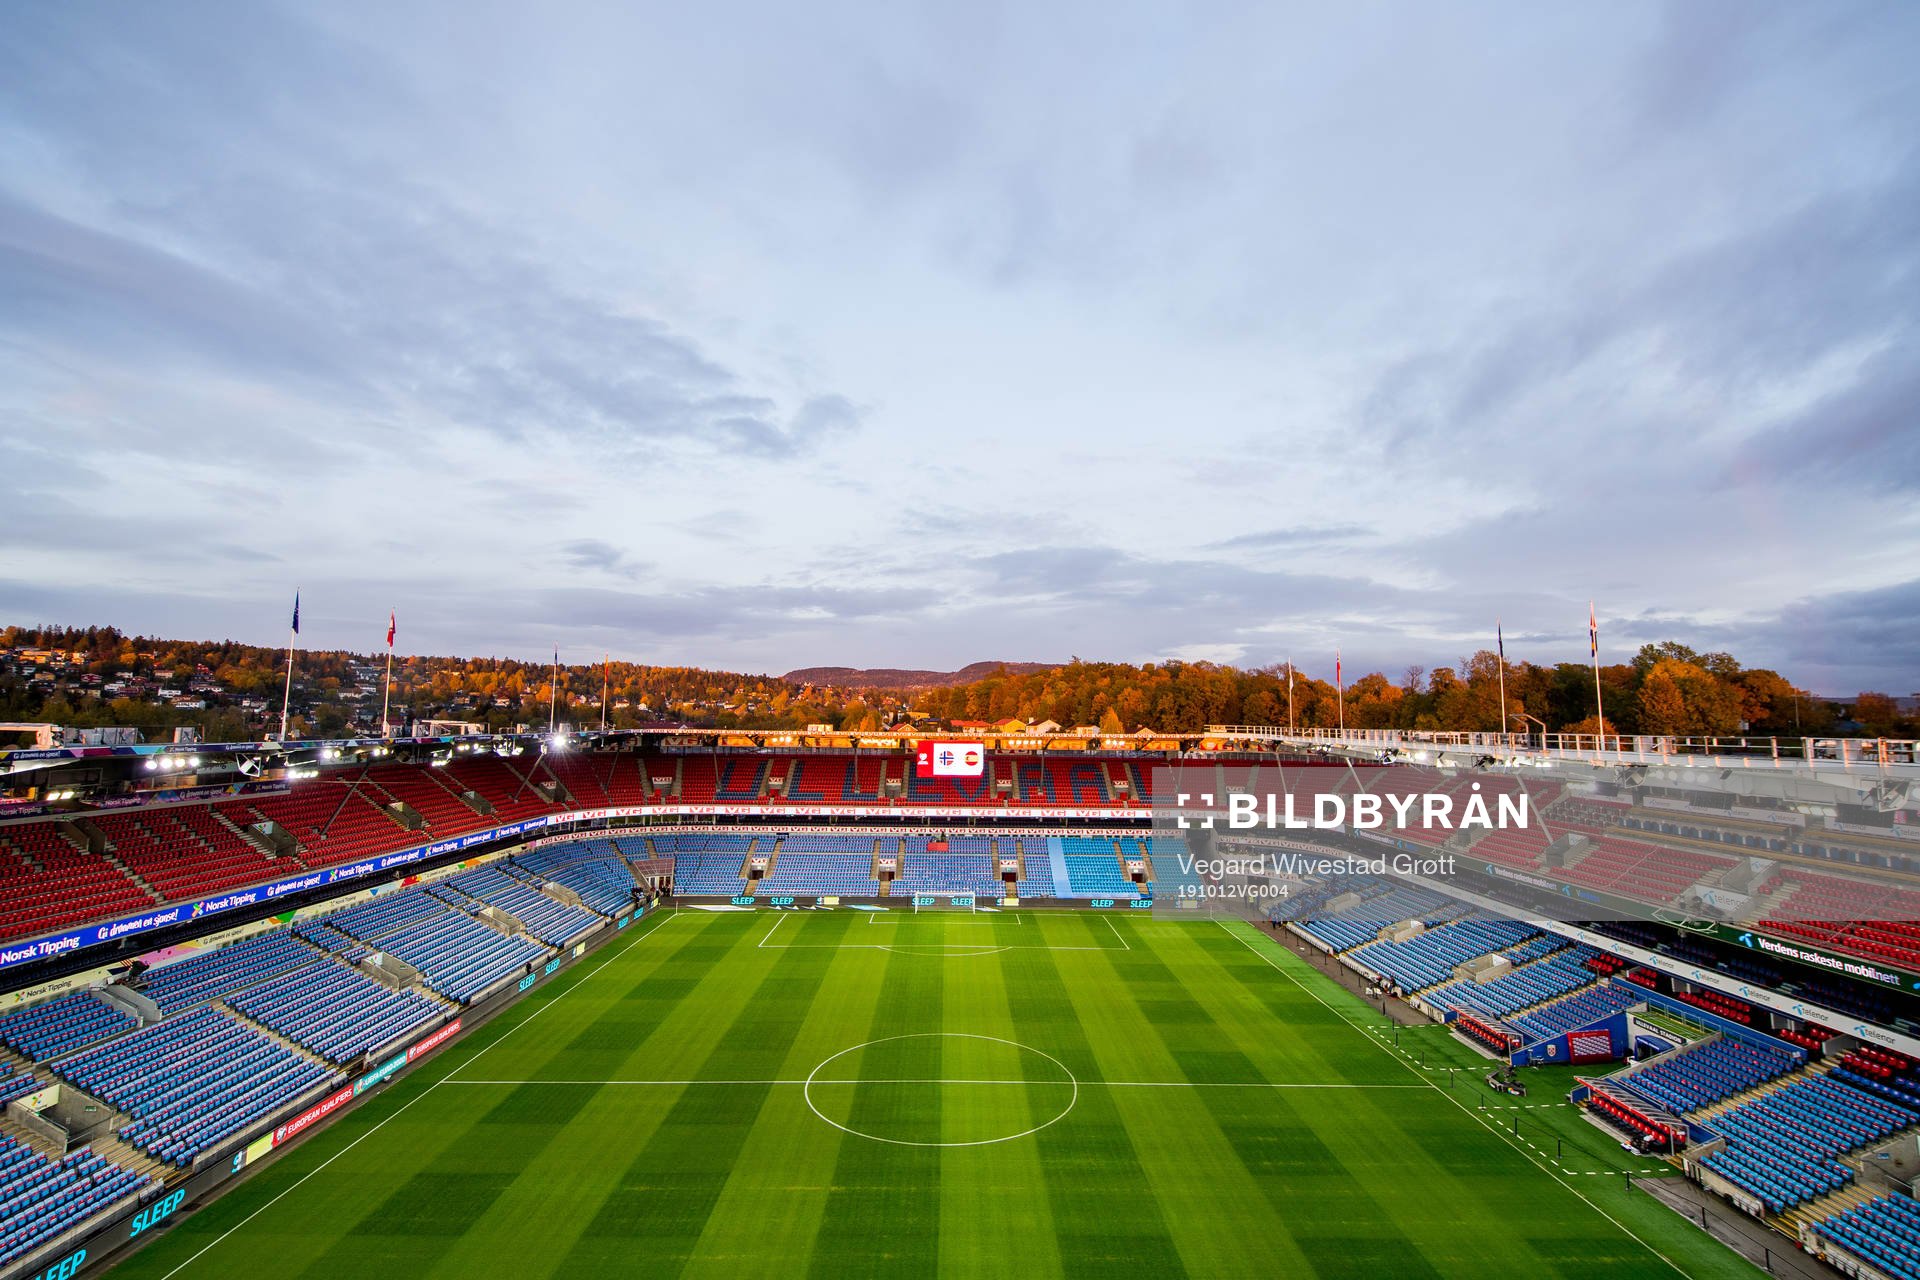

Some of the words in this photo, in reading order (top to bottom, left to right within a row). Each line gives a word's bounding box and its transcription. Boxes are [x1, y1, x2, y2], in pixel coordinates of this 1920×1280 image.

[338, 866, 354, 878] Norsk
[354, 863, 374, 876] Tipping
[206, 896, 229, 912] Norsk
[229, 892, 256, 906] Tipping
[732, 896, 754, 904] SLEEP
[771, 896, 794, 904] SLEEP
[1090, 900, 1114, 908] SLEEP
[1130, 900, 1153, 908] SLEEP
[0, 945, 38, 964] Norsk
[38, 936, 80, 955] Tipping
[1758, 938, 1799, 958] Verdens
[1800, 950, 1843, 970] raskeste
[1844, 963, 1900, 986] mobilnett
[26, 986, 47, 998] Norsk
[48, 980, 72, 992] Tipping
[519, 974, 536, 992] SLEEP
[1802, 1006, 1829, 1022] telenor
[416, 1036, 439, 1054] EUROPEAN
[439, 1022, 460, 1042] QUALIFIERS
[1864, 1028, 1896, 1045] telenor
[288, 1110, 320, 1134] EUROPEAN
[320, 1088, 352, 1118] QUALIFIERS
[130, 1188, 185, 1238] SLEEP
[35, 1249, 86, 1280] EEP
